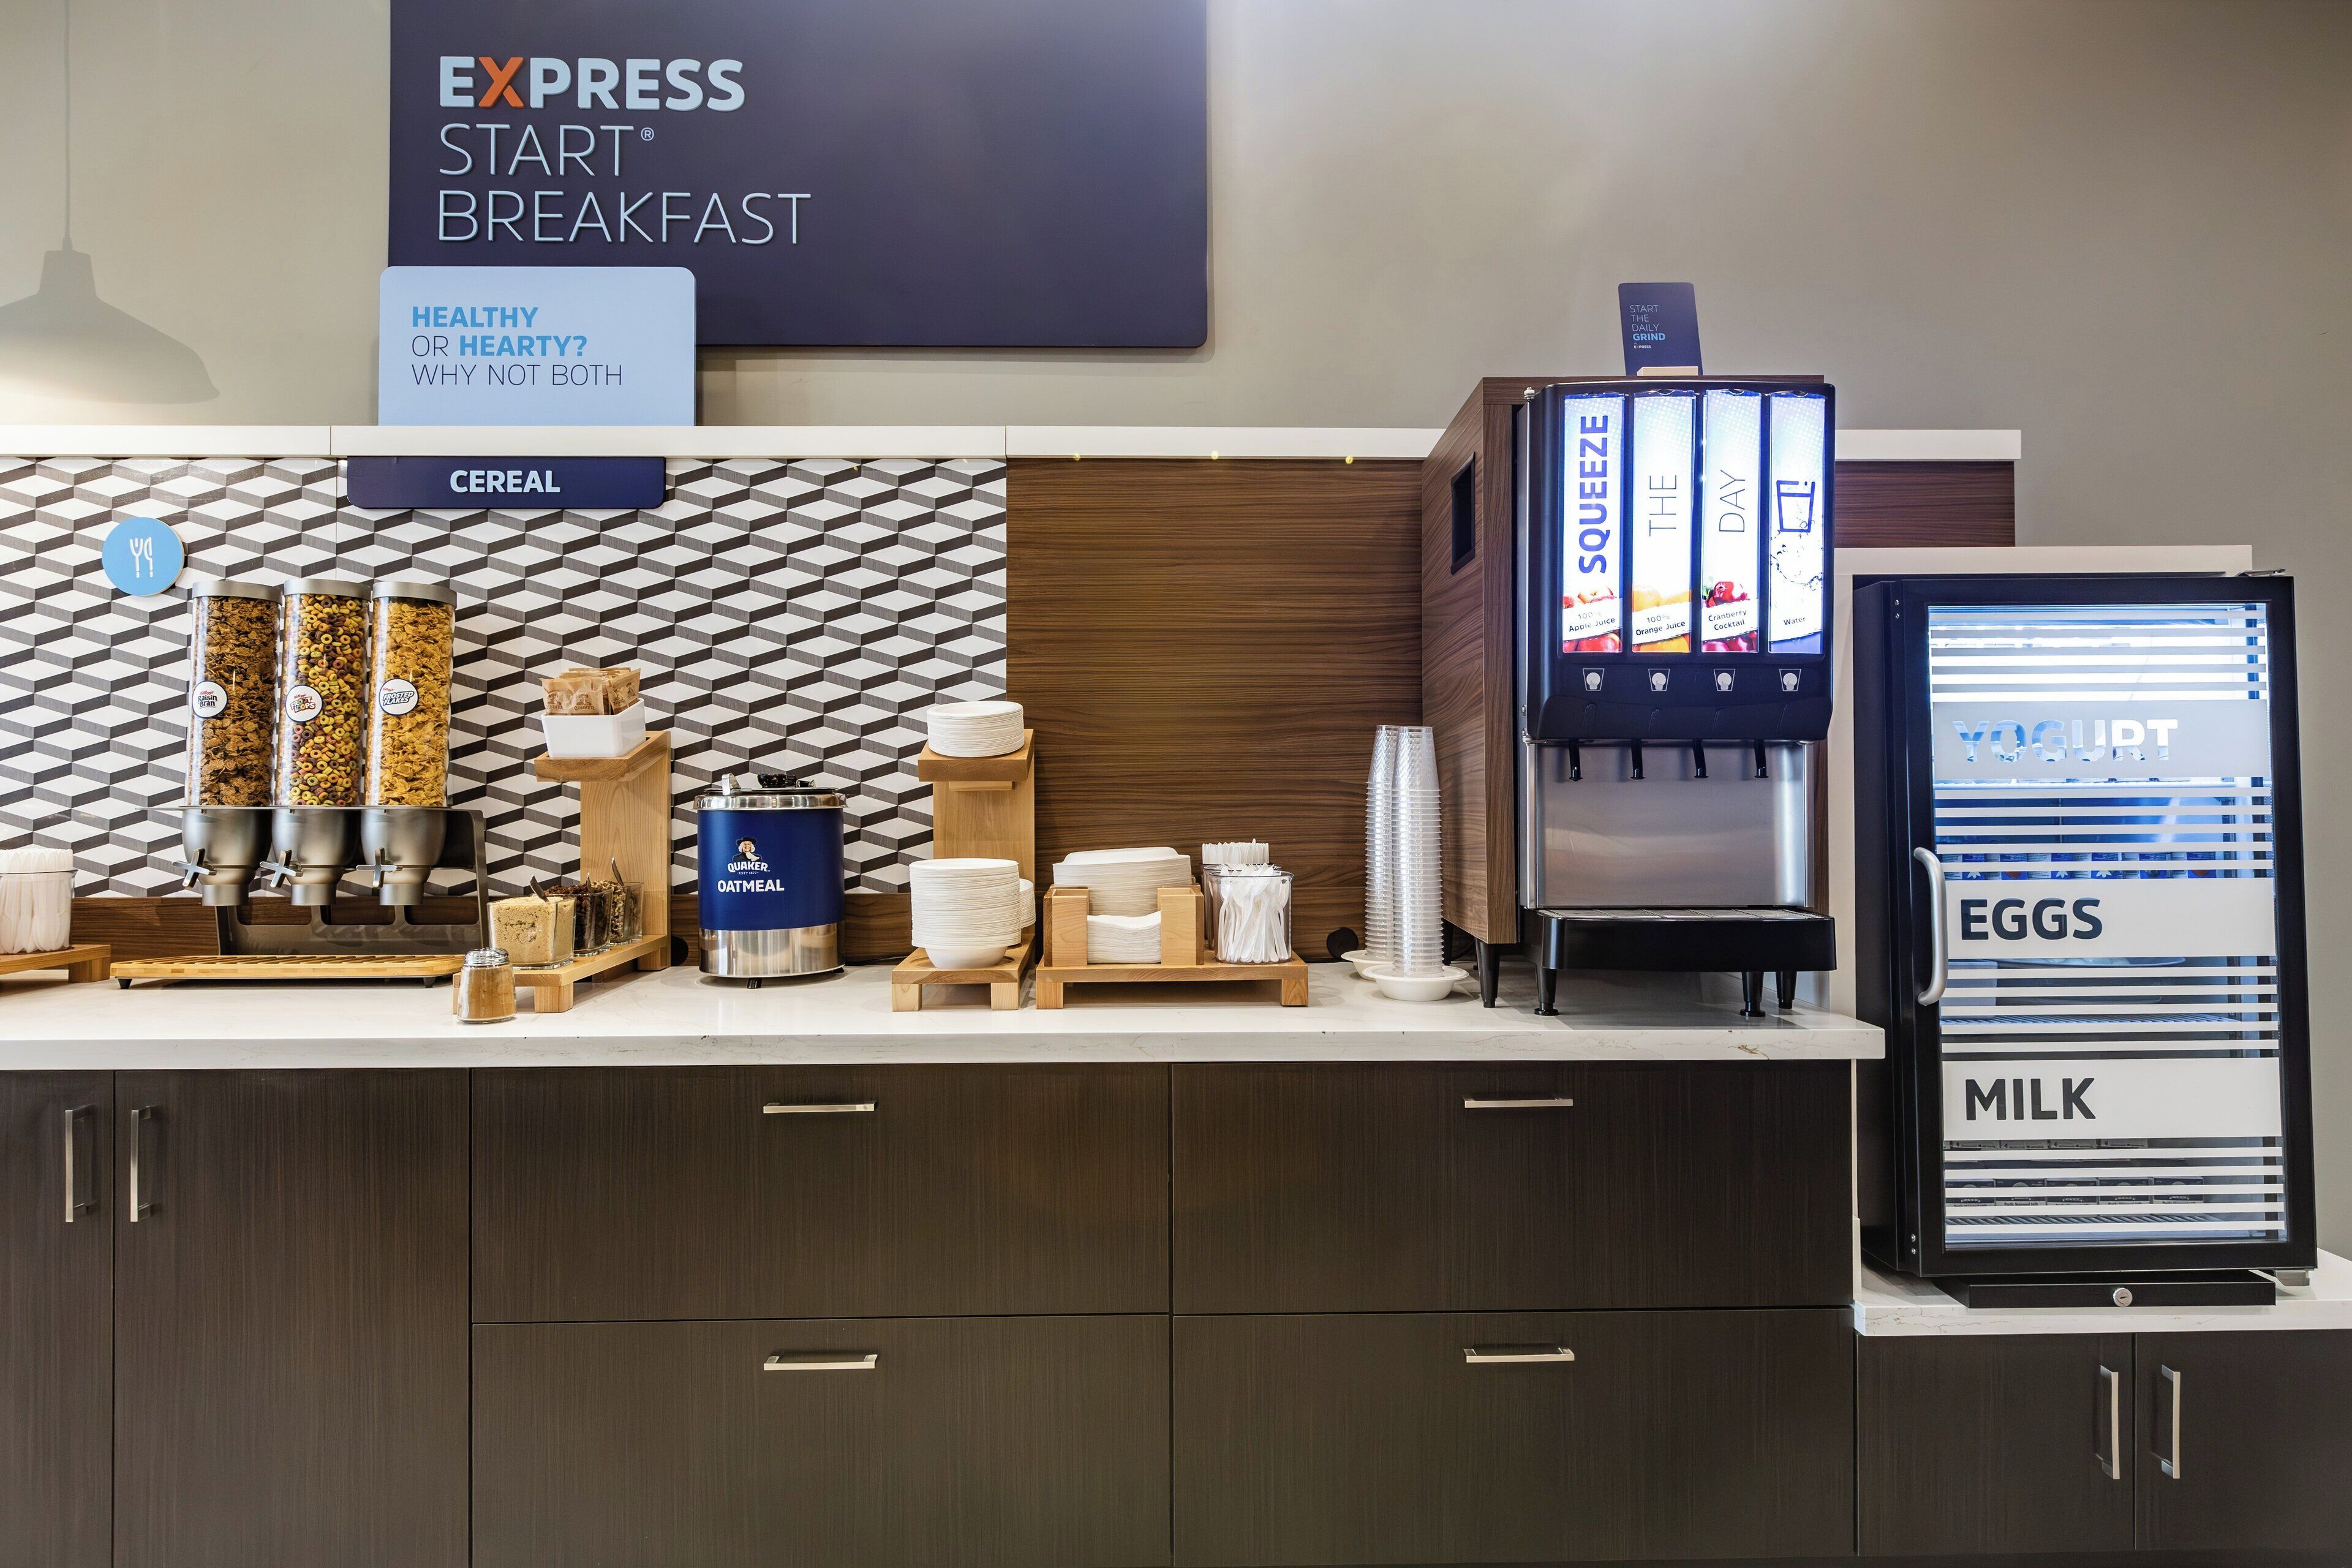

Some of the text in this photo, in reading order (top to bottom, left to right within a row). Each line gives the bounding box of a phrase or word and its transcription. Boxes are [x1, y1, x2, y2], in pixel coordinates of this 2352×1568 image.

[440, 56, 745, 111] EXPRESS
[439, 190, 811, 245] BREAKFAST
[412, 306, 538, 328] HEALTHY
[1629, 304, 1659, 313] START
[412, 335, 588, 357] OR HEARTY?
[412, 364, 622, 386] WHY NOT BOTH
[450, 470, 560, 493] CEREAL
[1578, 415, 1610, 574] SQUEEZE
[1719, 469, 1746, 532] DAY
[1649, 475, 1677, 537] THE
[1569, 617, 1616, 632] Apple Juice
[1646, 614, 1670, 624] 100%
[1708, 610, 1747, 622] Cranberry
[1714, 619, 1745, 630] Cocktail
[1783, 617, 1806, 625] Water
[1635, 620, 1686, 636] Orange Juice
[383, 691, 415, 701] FROSTED
[383, 697, 410, 706] FLAKES
[1952, 719, 2178, 762] YOGURT
[717, 880, 785, 892] OATMEAL
[1961, 897, 2103, 940] EGGS
[1965, 1078, 2096, 1120] MILK
